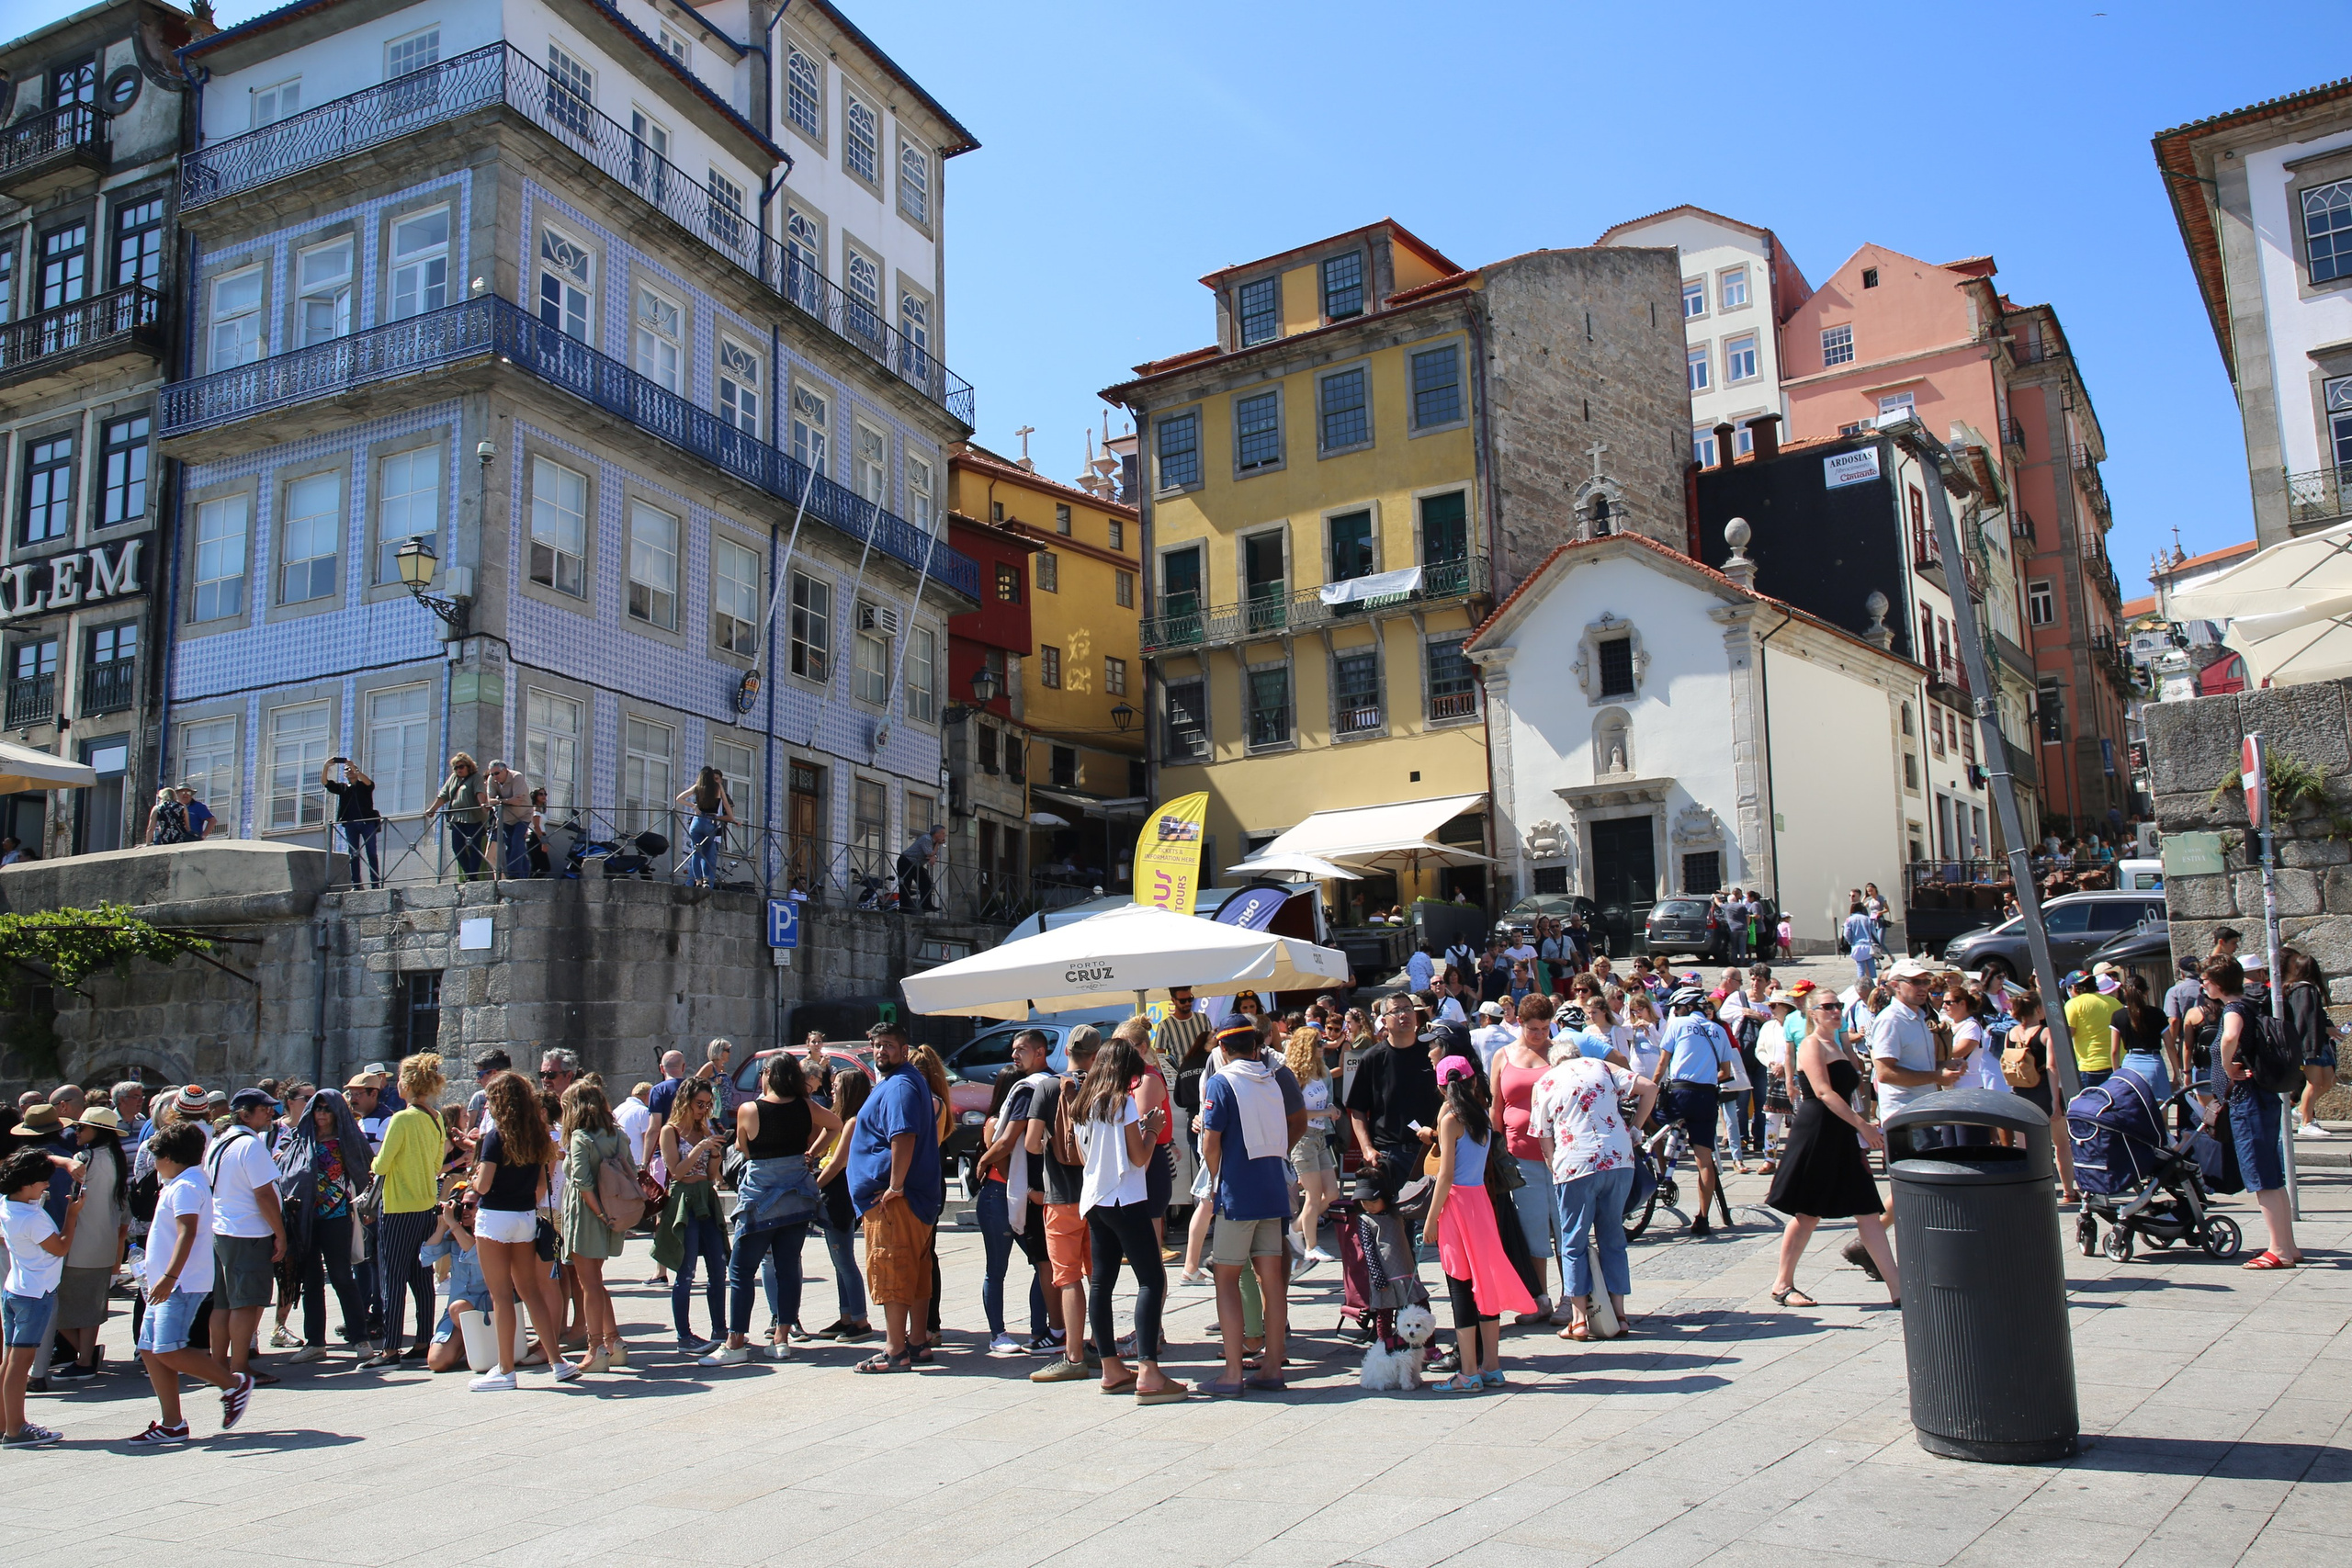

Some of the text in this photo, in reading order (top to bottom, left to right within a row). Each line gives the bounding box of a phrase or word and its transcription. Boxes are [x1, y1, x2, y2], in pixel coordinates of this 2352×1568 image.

[1830, 452, 1872, 468] ARDOSIAS
[1145, 853, 1181, 862] INFORMATION
[1175, 875, 1187, 911] TOURS
[772, 902, 792, 942] P
[1069, 961, 1105, 970] PORTO
[1065, 967, 1114, 983] CRUZ
[1687, 1026, 1721, 1040] POLCIA
[1193, 1067, 1205, 1076] HER
